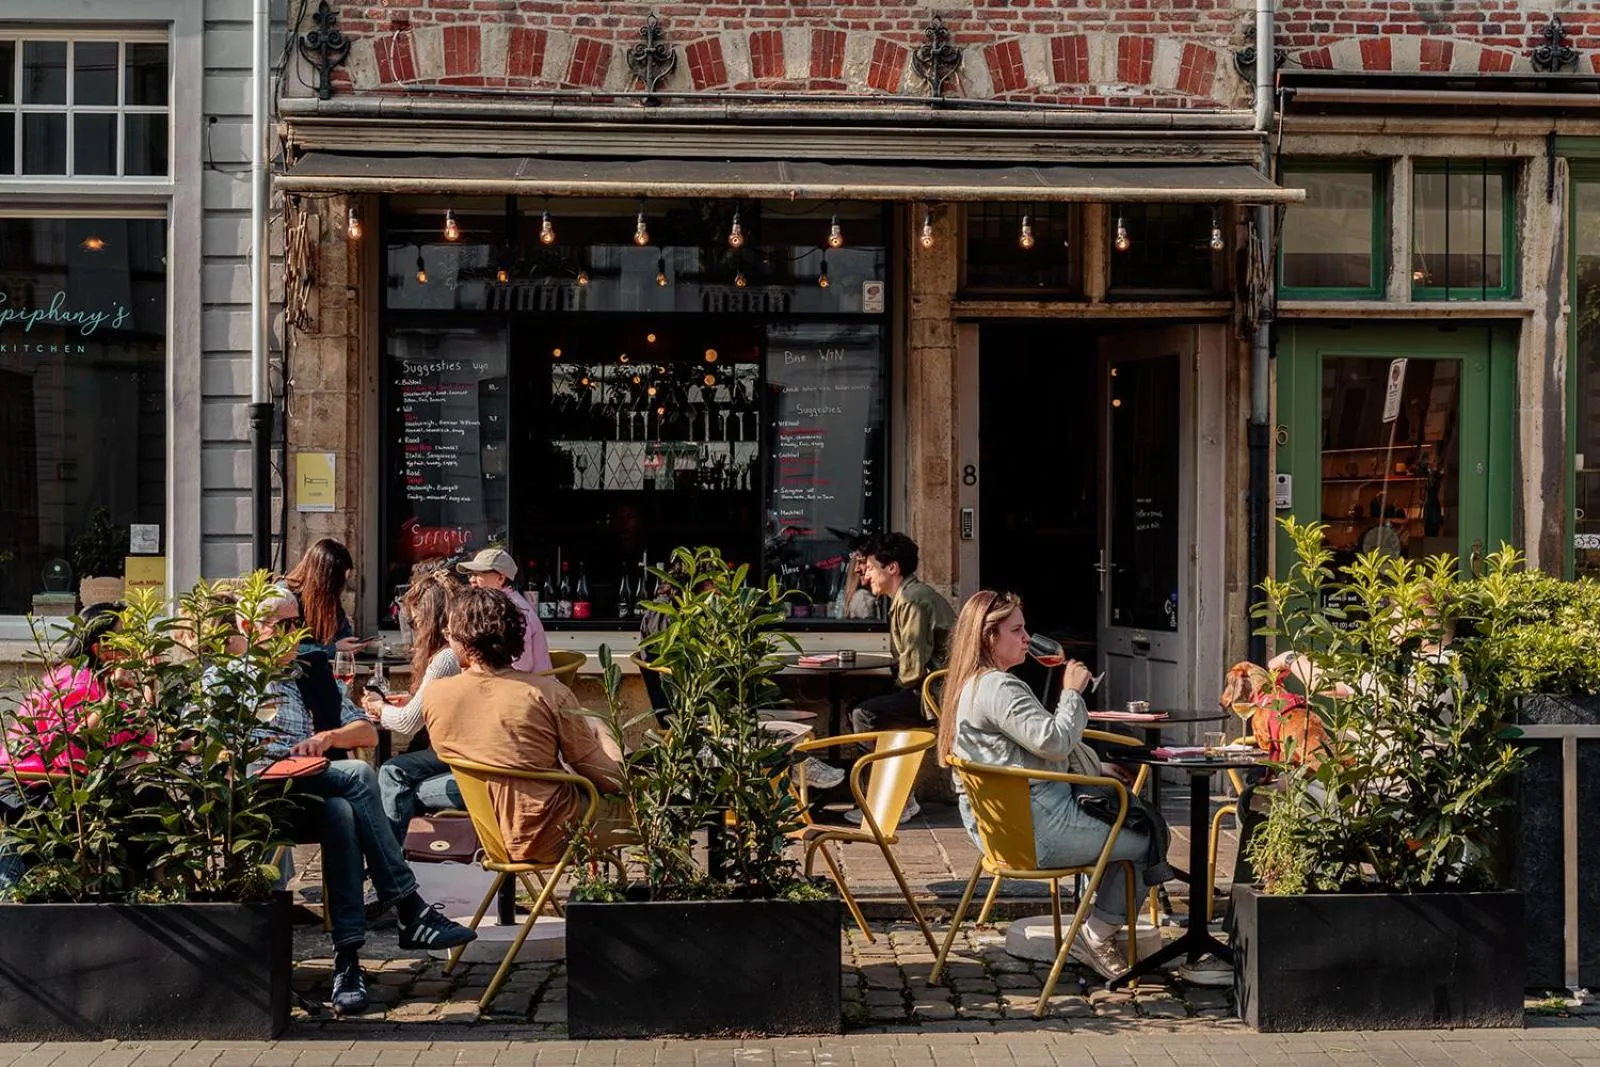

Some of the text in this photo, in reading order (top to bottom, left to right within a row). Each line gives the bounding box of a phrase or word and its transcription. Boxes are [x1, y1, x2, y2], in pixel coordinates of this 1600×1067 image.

[0, 344, 86, 353] KITCHEN
[403, 360, 462, 376] Suggesties
[796, 403, 843, 417] Suggesties
[1276, 424, 1288, 445] 6
[963, 465, 976, 486] 8
